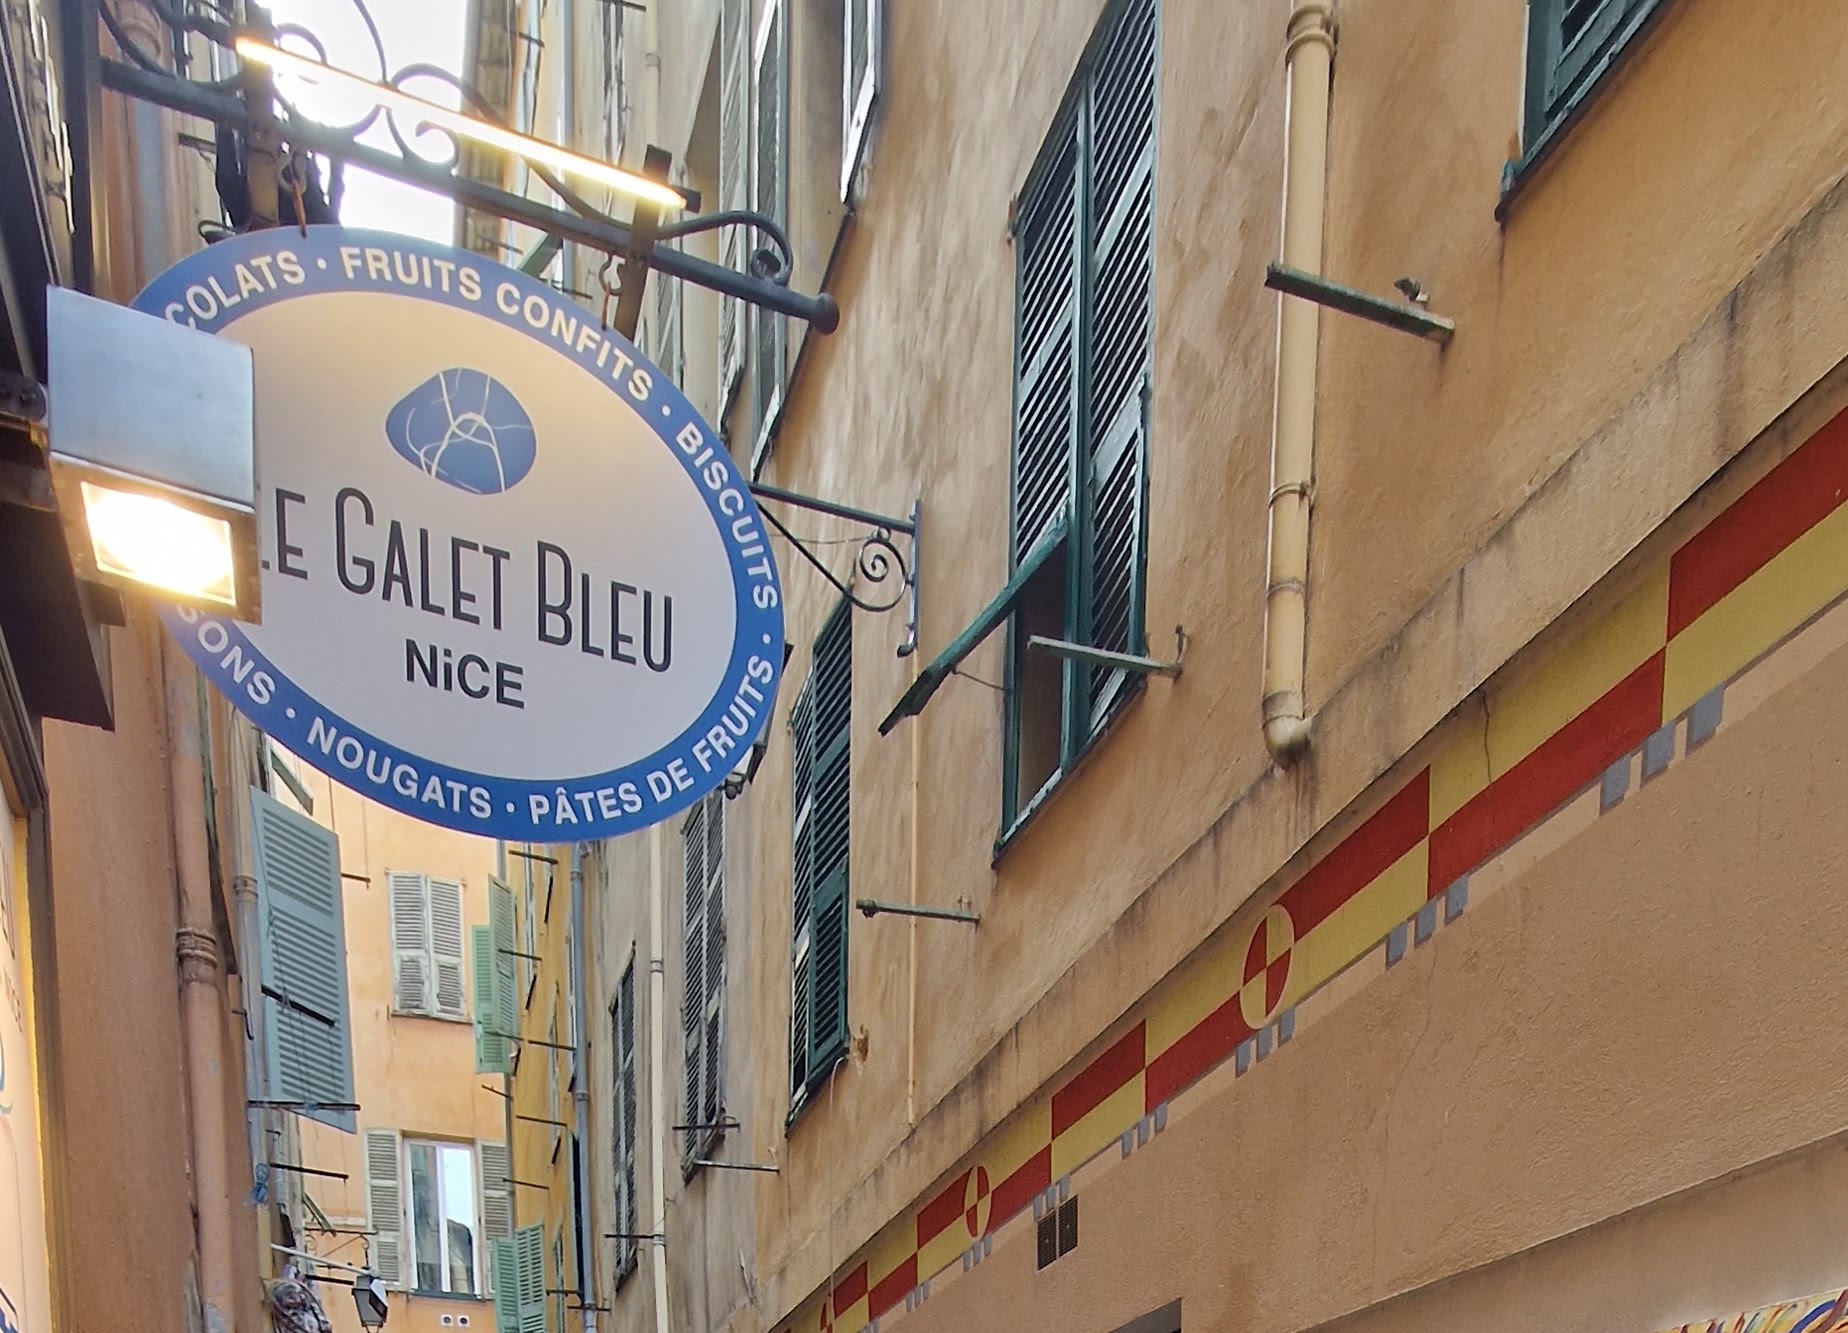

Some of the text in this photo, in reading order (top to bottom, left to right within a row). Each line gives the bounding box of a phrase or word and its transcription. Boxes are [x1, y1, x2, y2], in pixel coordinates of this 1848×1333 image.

[340, 246, 482, 301] FRUITS
[497, 283, 653, 401] CONFITS
[676, 422, 778, 609] BISCUITS
[262, 487, 308, 580] E
[307, 716, 491, 819] NOUGATS
[528, 781, 643, 825] PÂTES
[646, 756, 694, 801] DE
[692, 655, 774, 772] FRUITS
